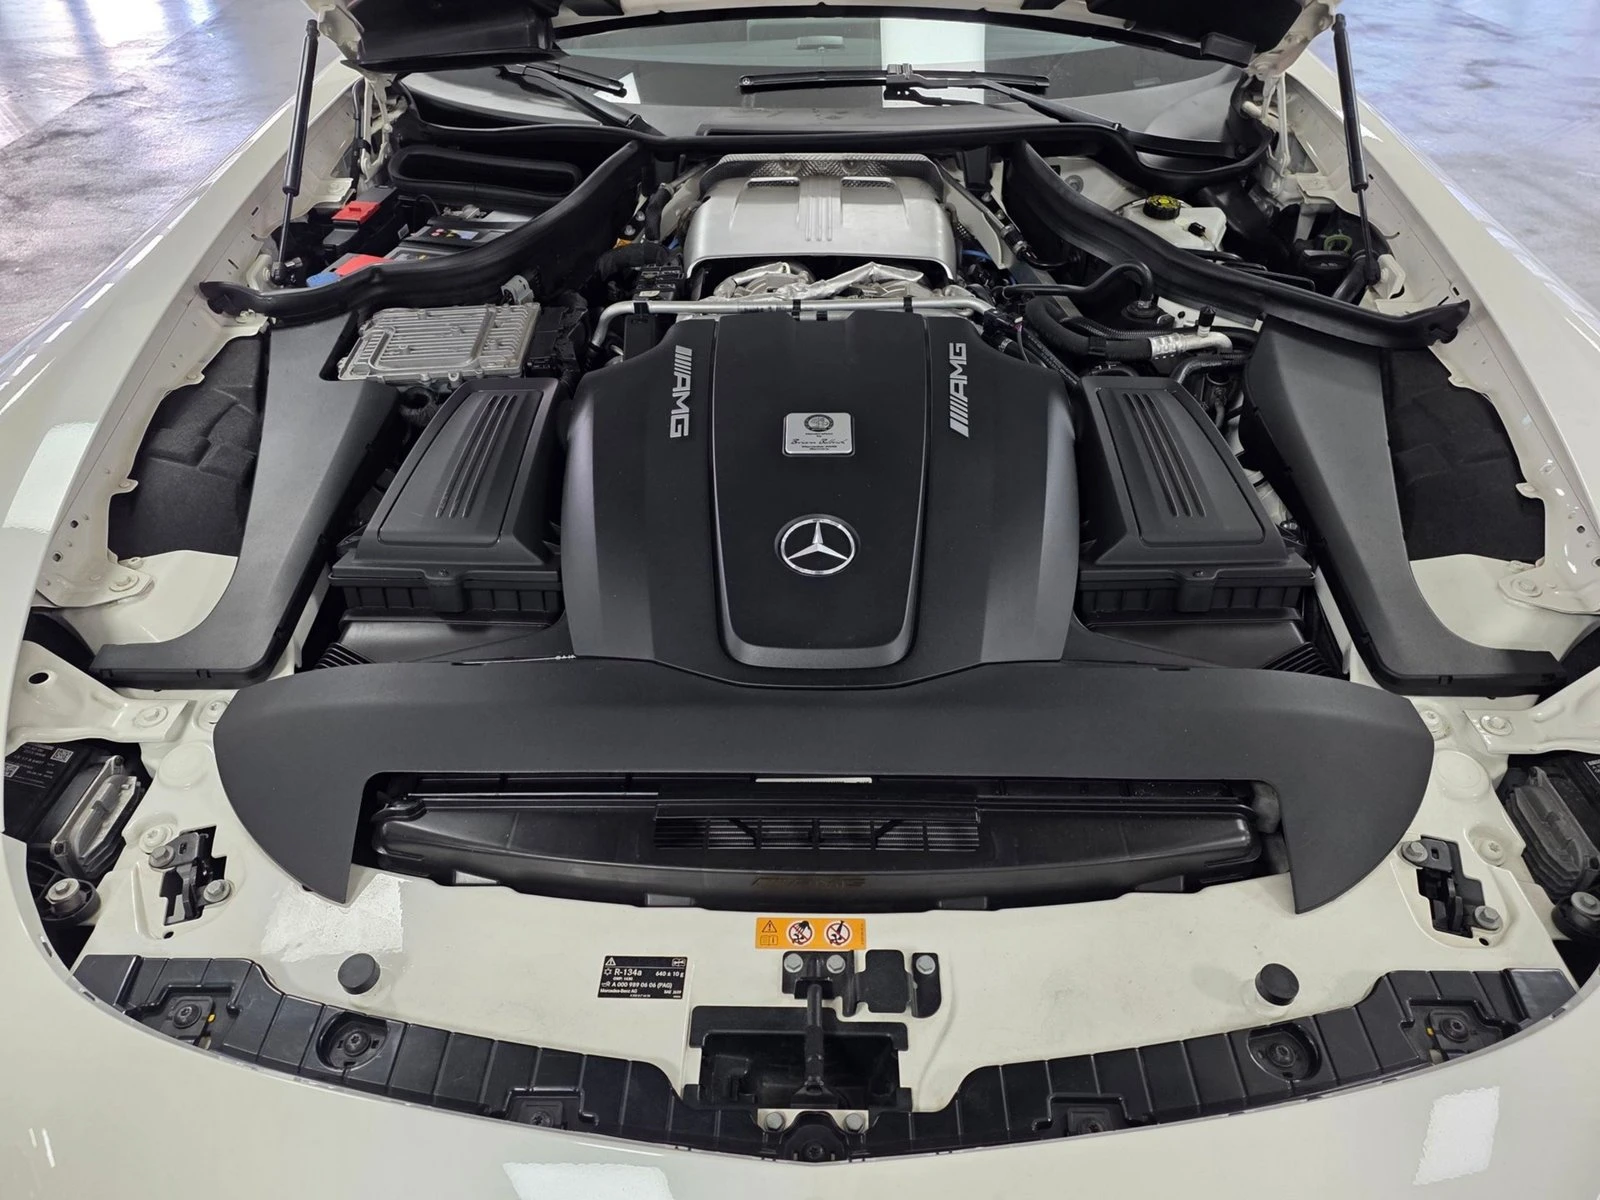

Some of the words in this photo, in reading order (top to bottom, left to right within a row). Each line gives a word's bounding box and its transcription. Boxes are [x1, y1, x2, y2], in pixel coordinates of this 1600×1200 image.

[670, 369, 691, 438] AMG
[949, 342, 968, 404] AMG
[614, 968, 642, 976] R-134a
